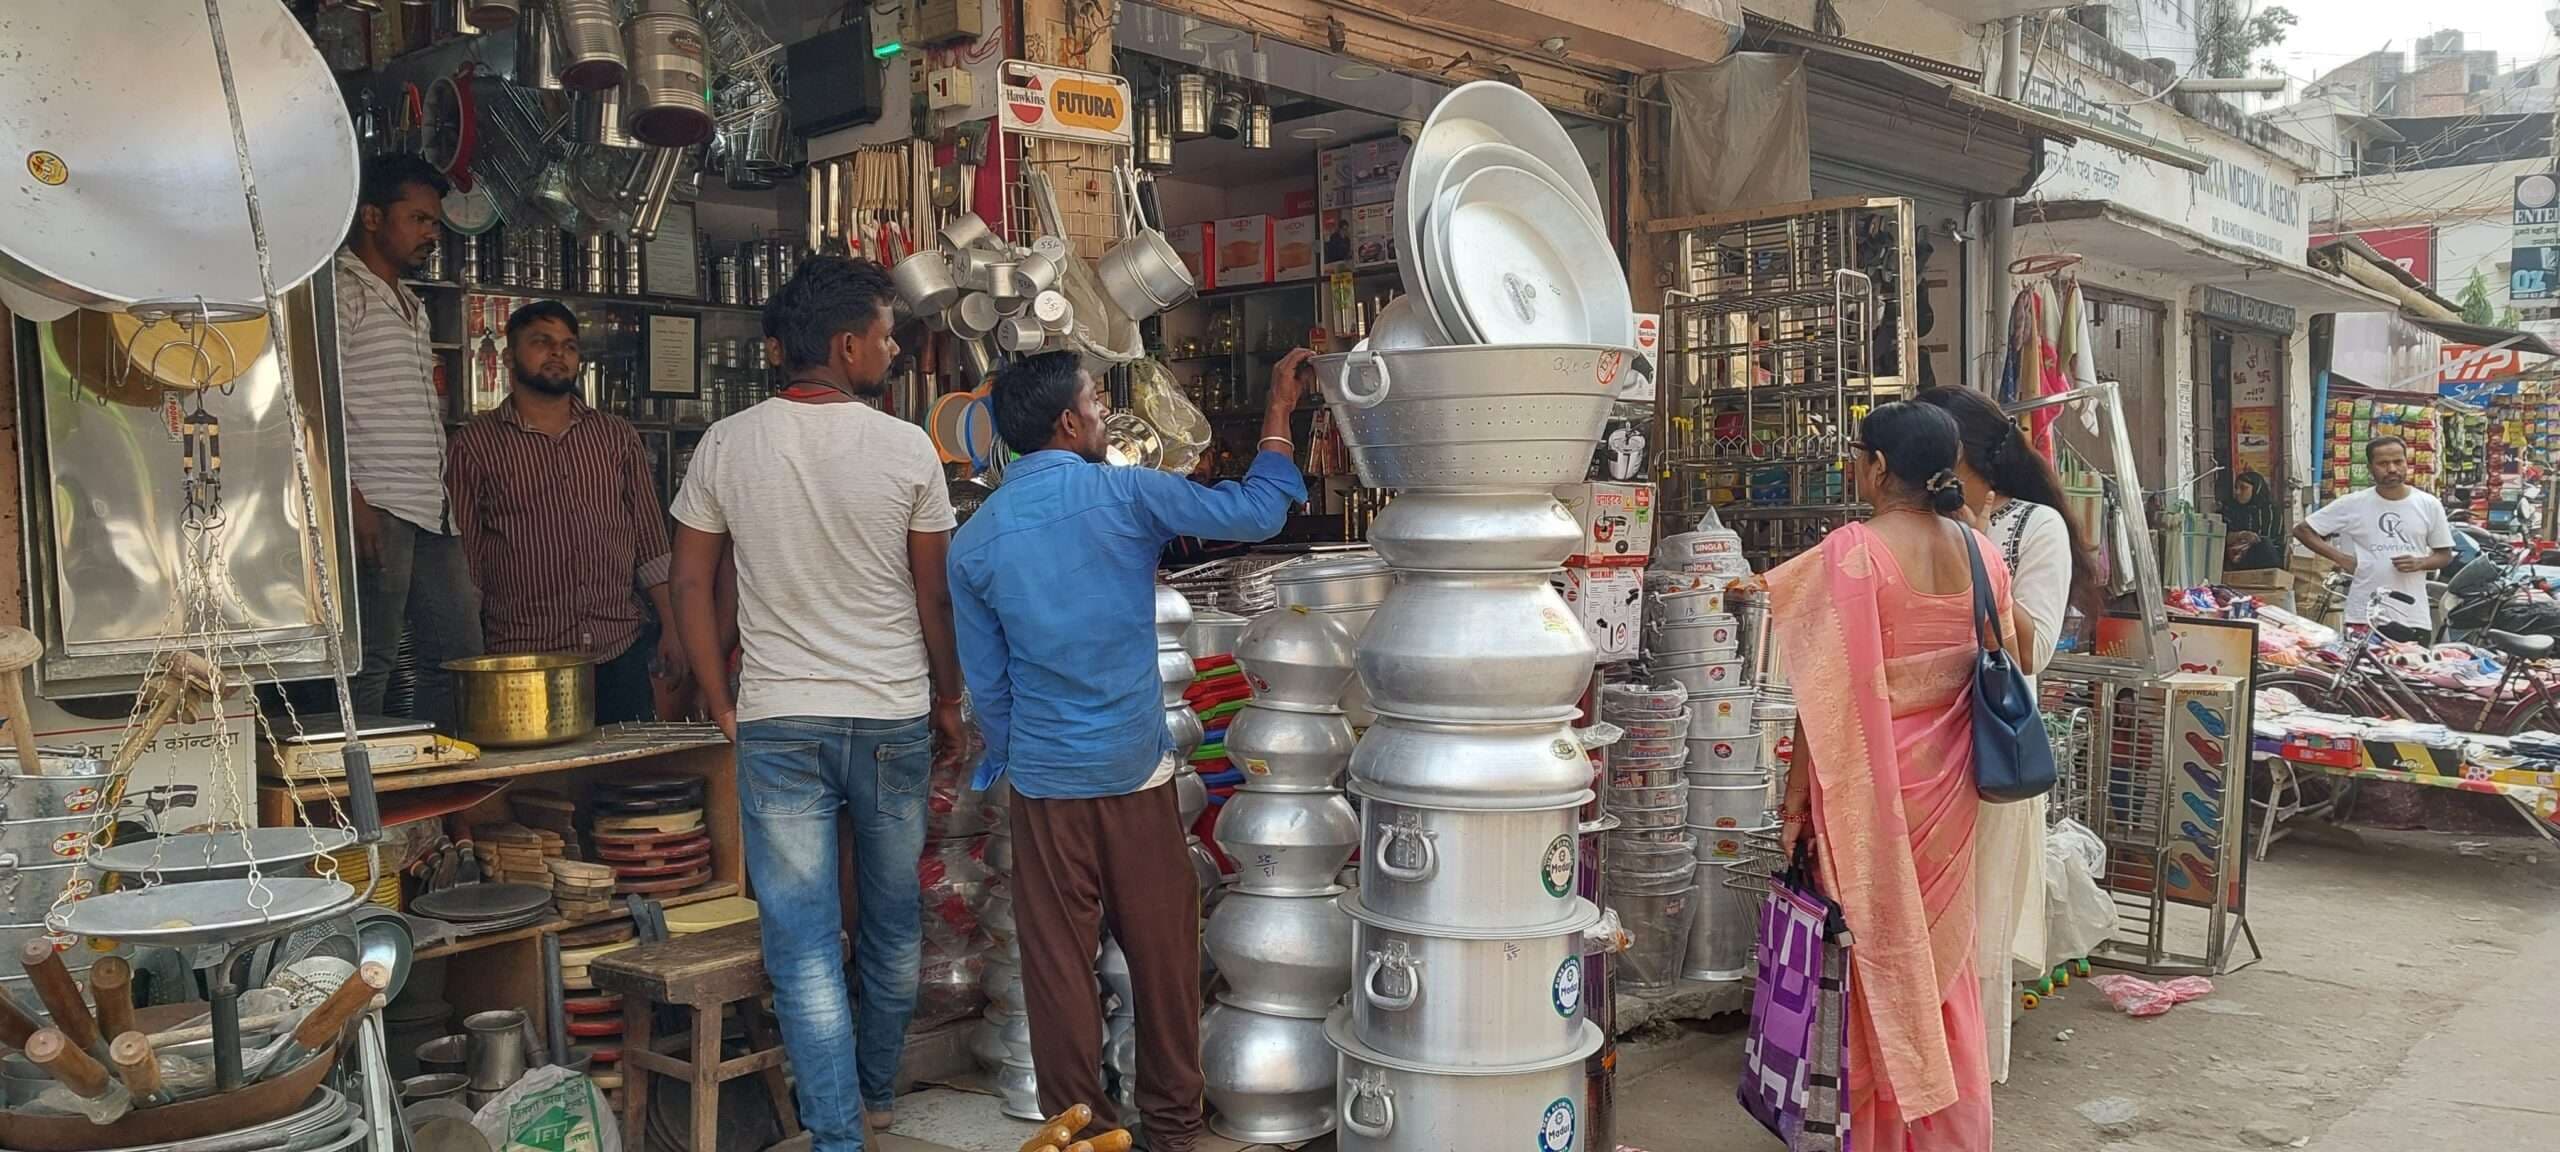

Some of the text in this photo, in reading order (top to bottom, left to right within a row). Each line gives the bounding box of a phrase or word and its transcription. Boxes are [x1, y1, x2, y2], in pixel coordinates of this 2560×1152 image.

[1006, 89, 1045, 105] Hawkins
[1057, 90, 1116, 119] FUTURA
[2228, 162, 2268, 217] MEDICAL
[2268, 181, 2301, 230] AGENCY
[2442, 348, 2513, 380] VIP
[1693, 542, 1722, 554] SINGLA
